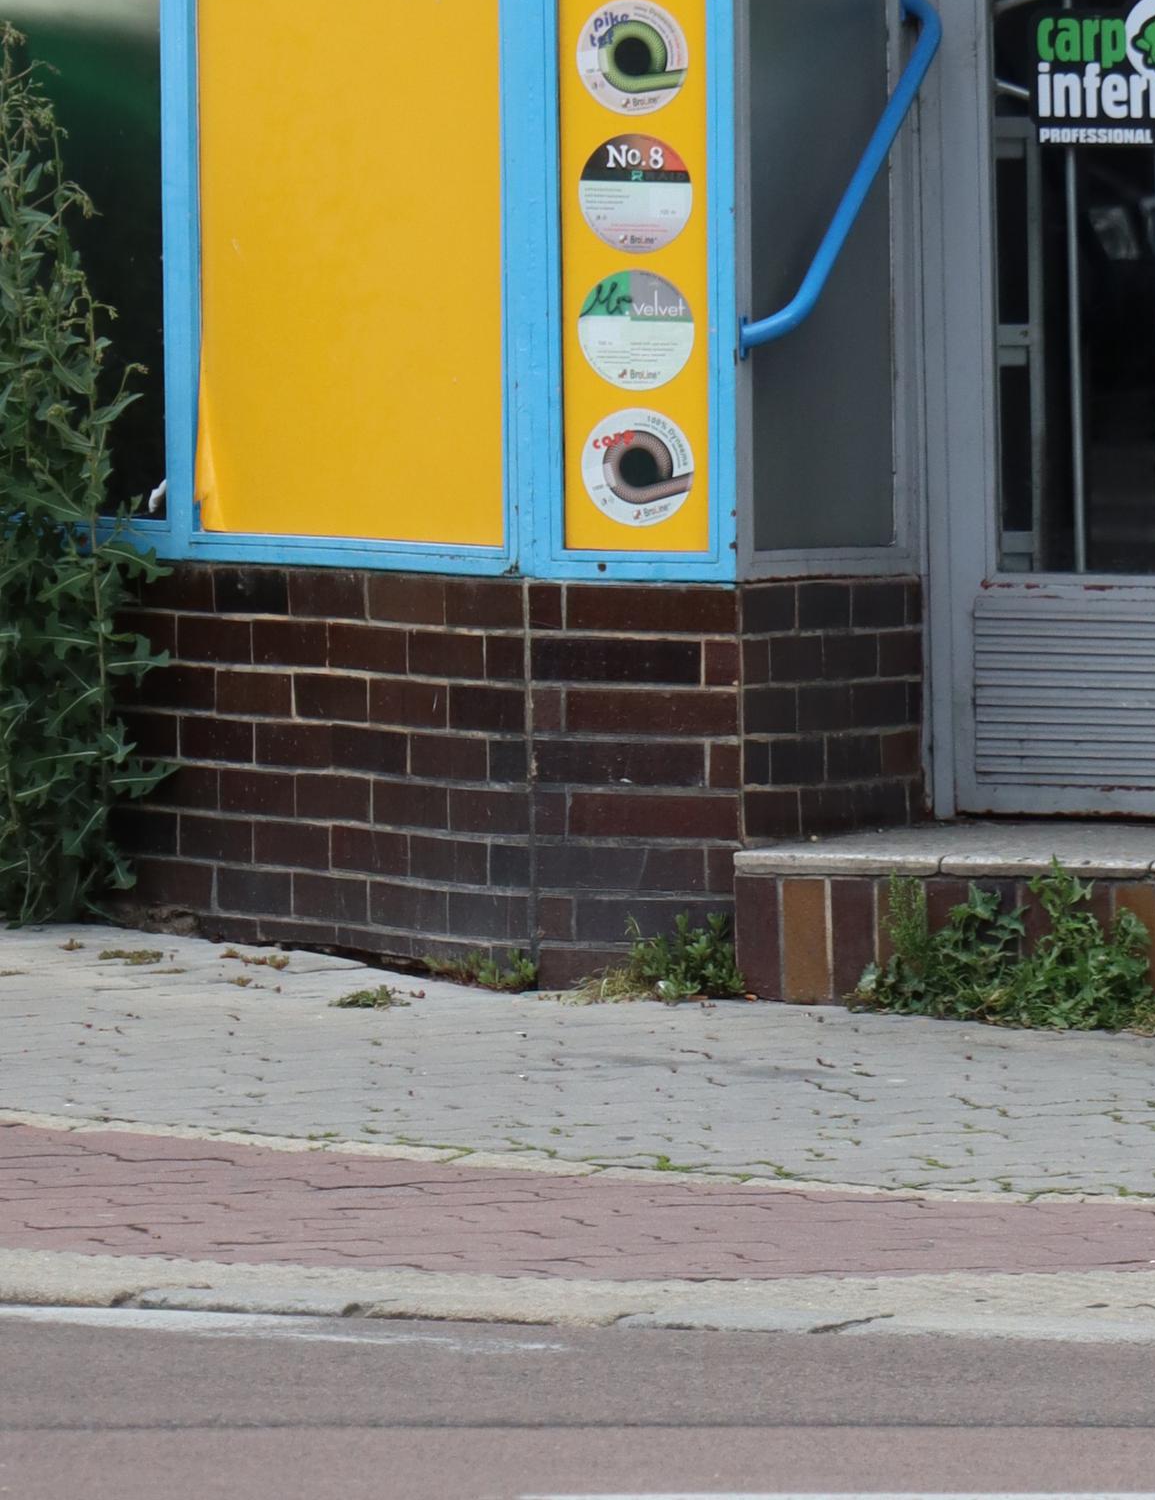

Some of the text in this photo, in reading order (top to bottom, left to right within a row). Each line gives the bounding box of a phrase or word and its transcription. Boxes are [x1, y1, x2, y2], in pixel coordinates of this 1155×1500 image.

[593, 11, 630, 32] pike
[1036, 16, 1127, 69] carp
[1039, 126, 1153, 144] PROFESSIONAL
[606, 144, 664, 169] No. 8
[593, 429, 636, 449] carp
